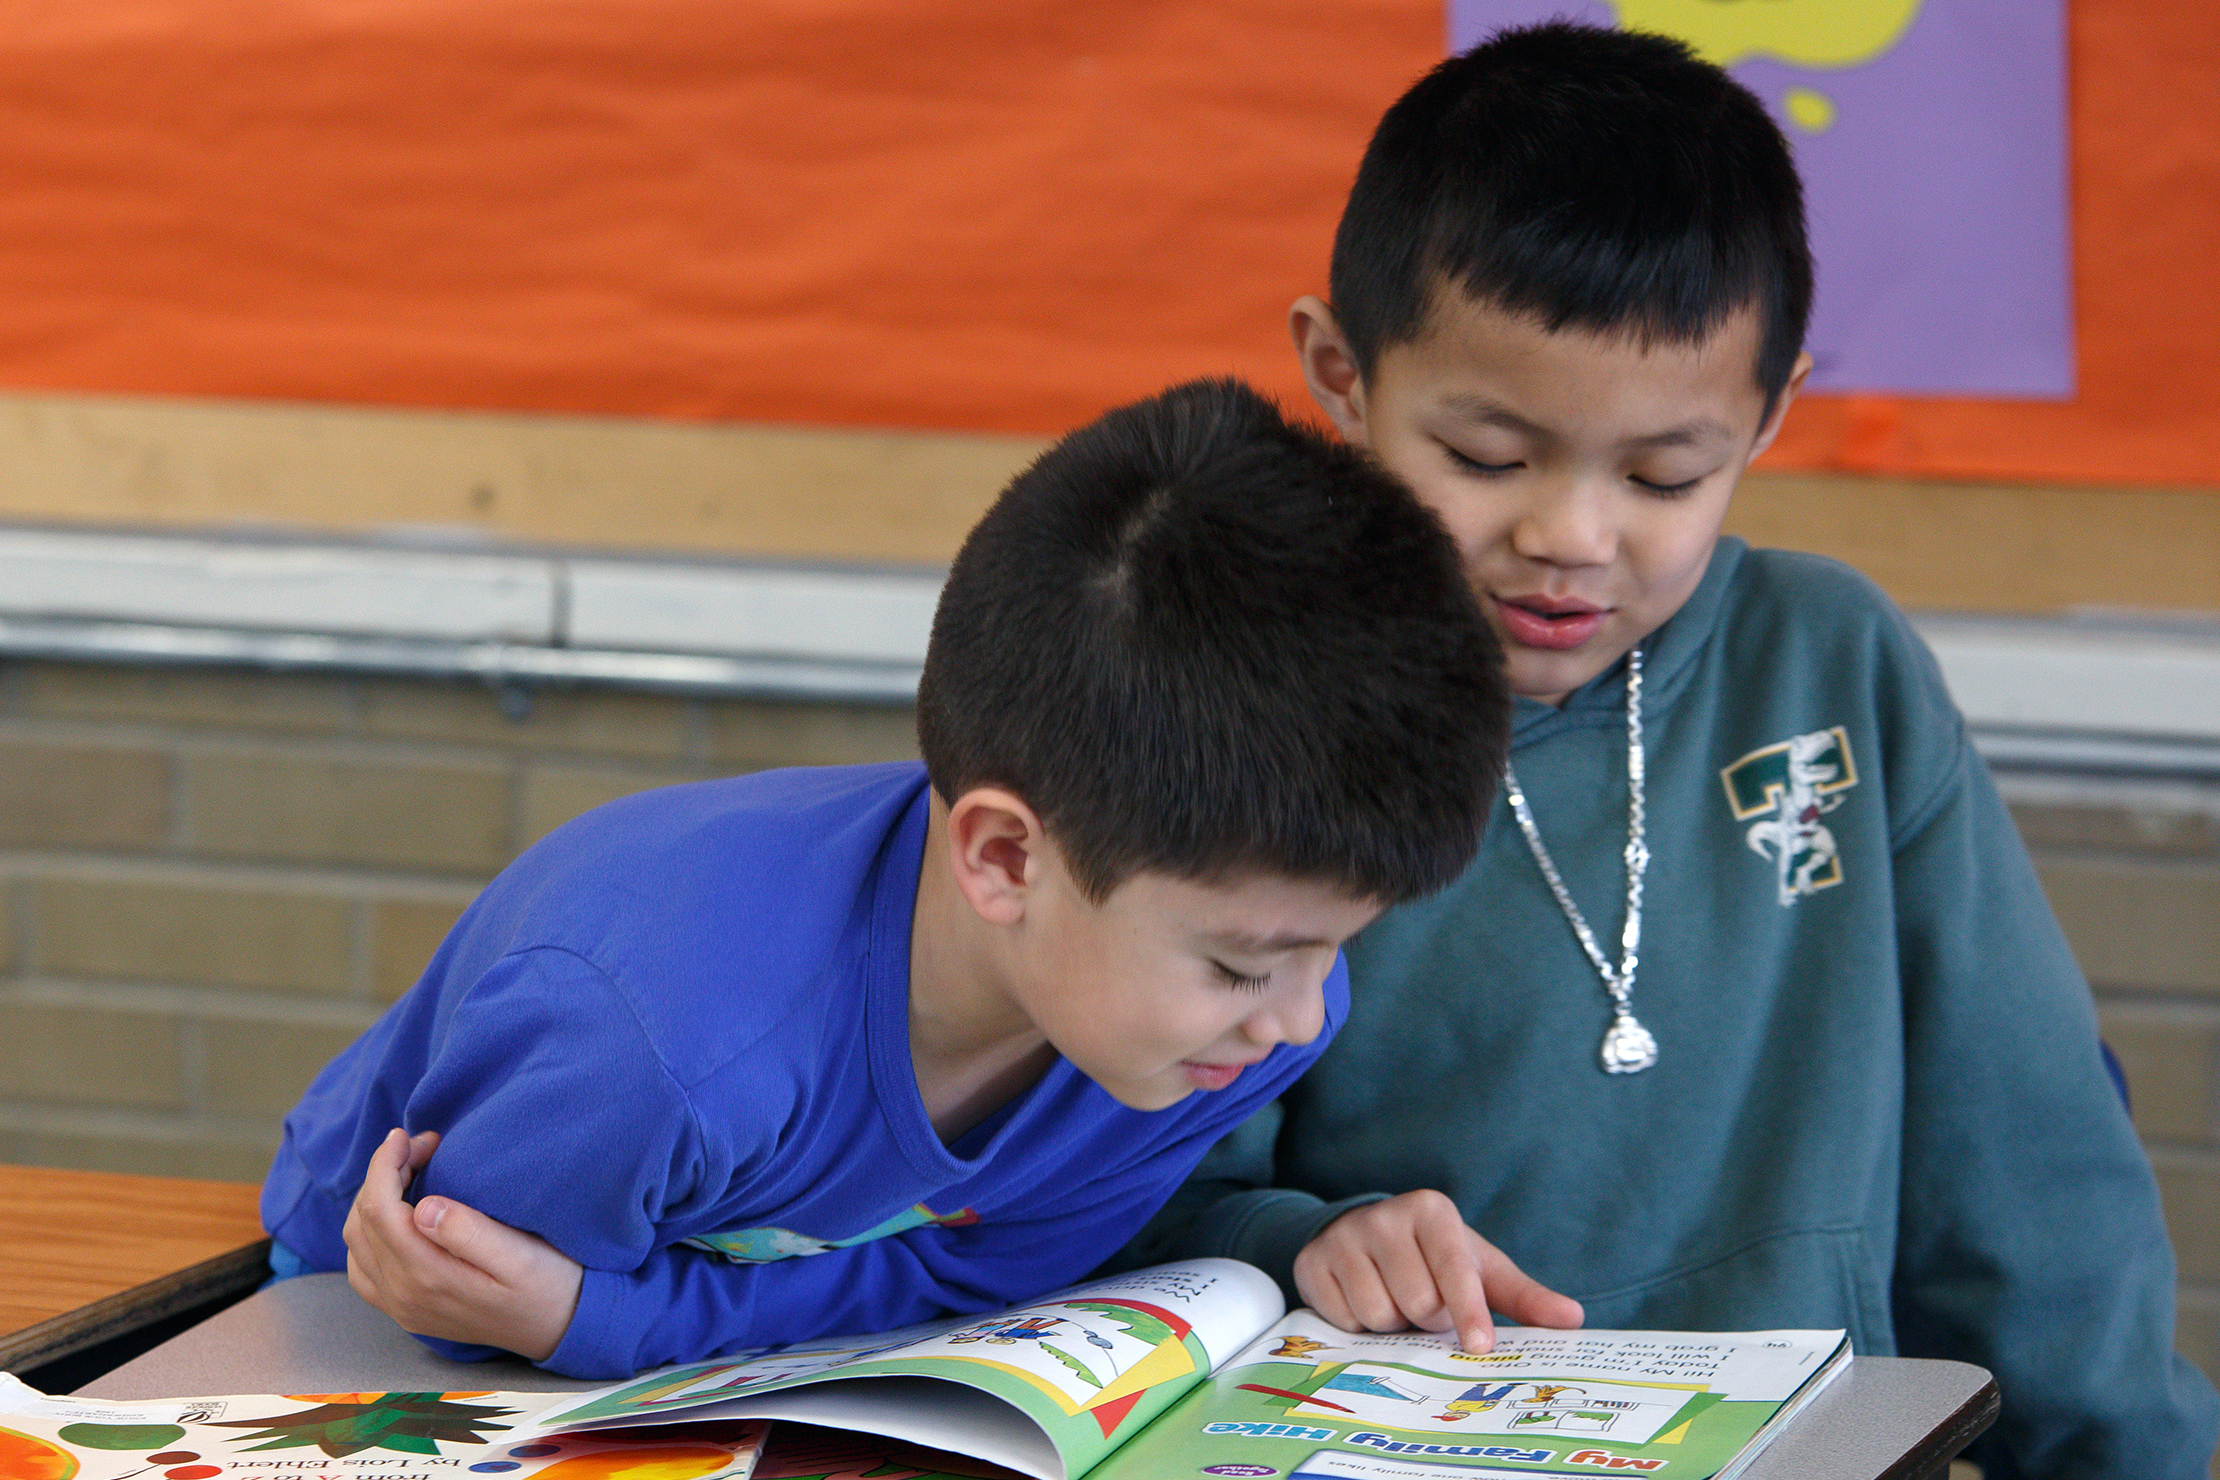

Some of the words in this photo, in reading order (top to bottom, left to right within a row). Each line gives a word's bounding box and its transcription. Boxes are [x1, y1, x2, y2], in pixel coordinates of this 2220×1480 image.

[1166, 1283, 1201, 1297] My
[1153, 1288, 1191, 1304] We
[1406, 1342, 1442, 1351] the
[1576, 1341, 1614, 1349] hat
[1622, 1342, 1657, 1350] my
[1665, 1344, 1719, 1354] grab
[1529, 1353, 1596, 1361] going
[1615, 1351, 1664, 1360] look
[1671, 1352, 1711, 1361] will
[1565, 1362, 1632, 1372] name
[1603, 1358, 1643, 1367] I'm
[1652, 1360, 1721, 1370] Today
[1639, 1367, 1676, 1377] My
[1683, 1370, 1715, 1378] Hi!
[1204, 1422, 1337, 1442] Hike
[1346, 1432, 1554, 1463] Family
[226, 1459, 333, 1470] Ehlert
[341, 1459, 411, 1469] Lois
[421, 1457, 461, 1468] by
[1328, 1461, 1367, 1471] likes
[1566, 1450, 1666, 1472] My
[1213, 1465, 1271, 1474] Together
[1372, 1467, 1425, 1477] family
